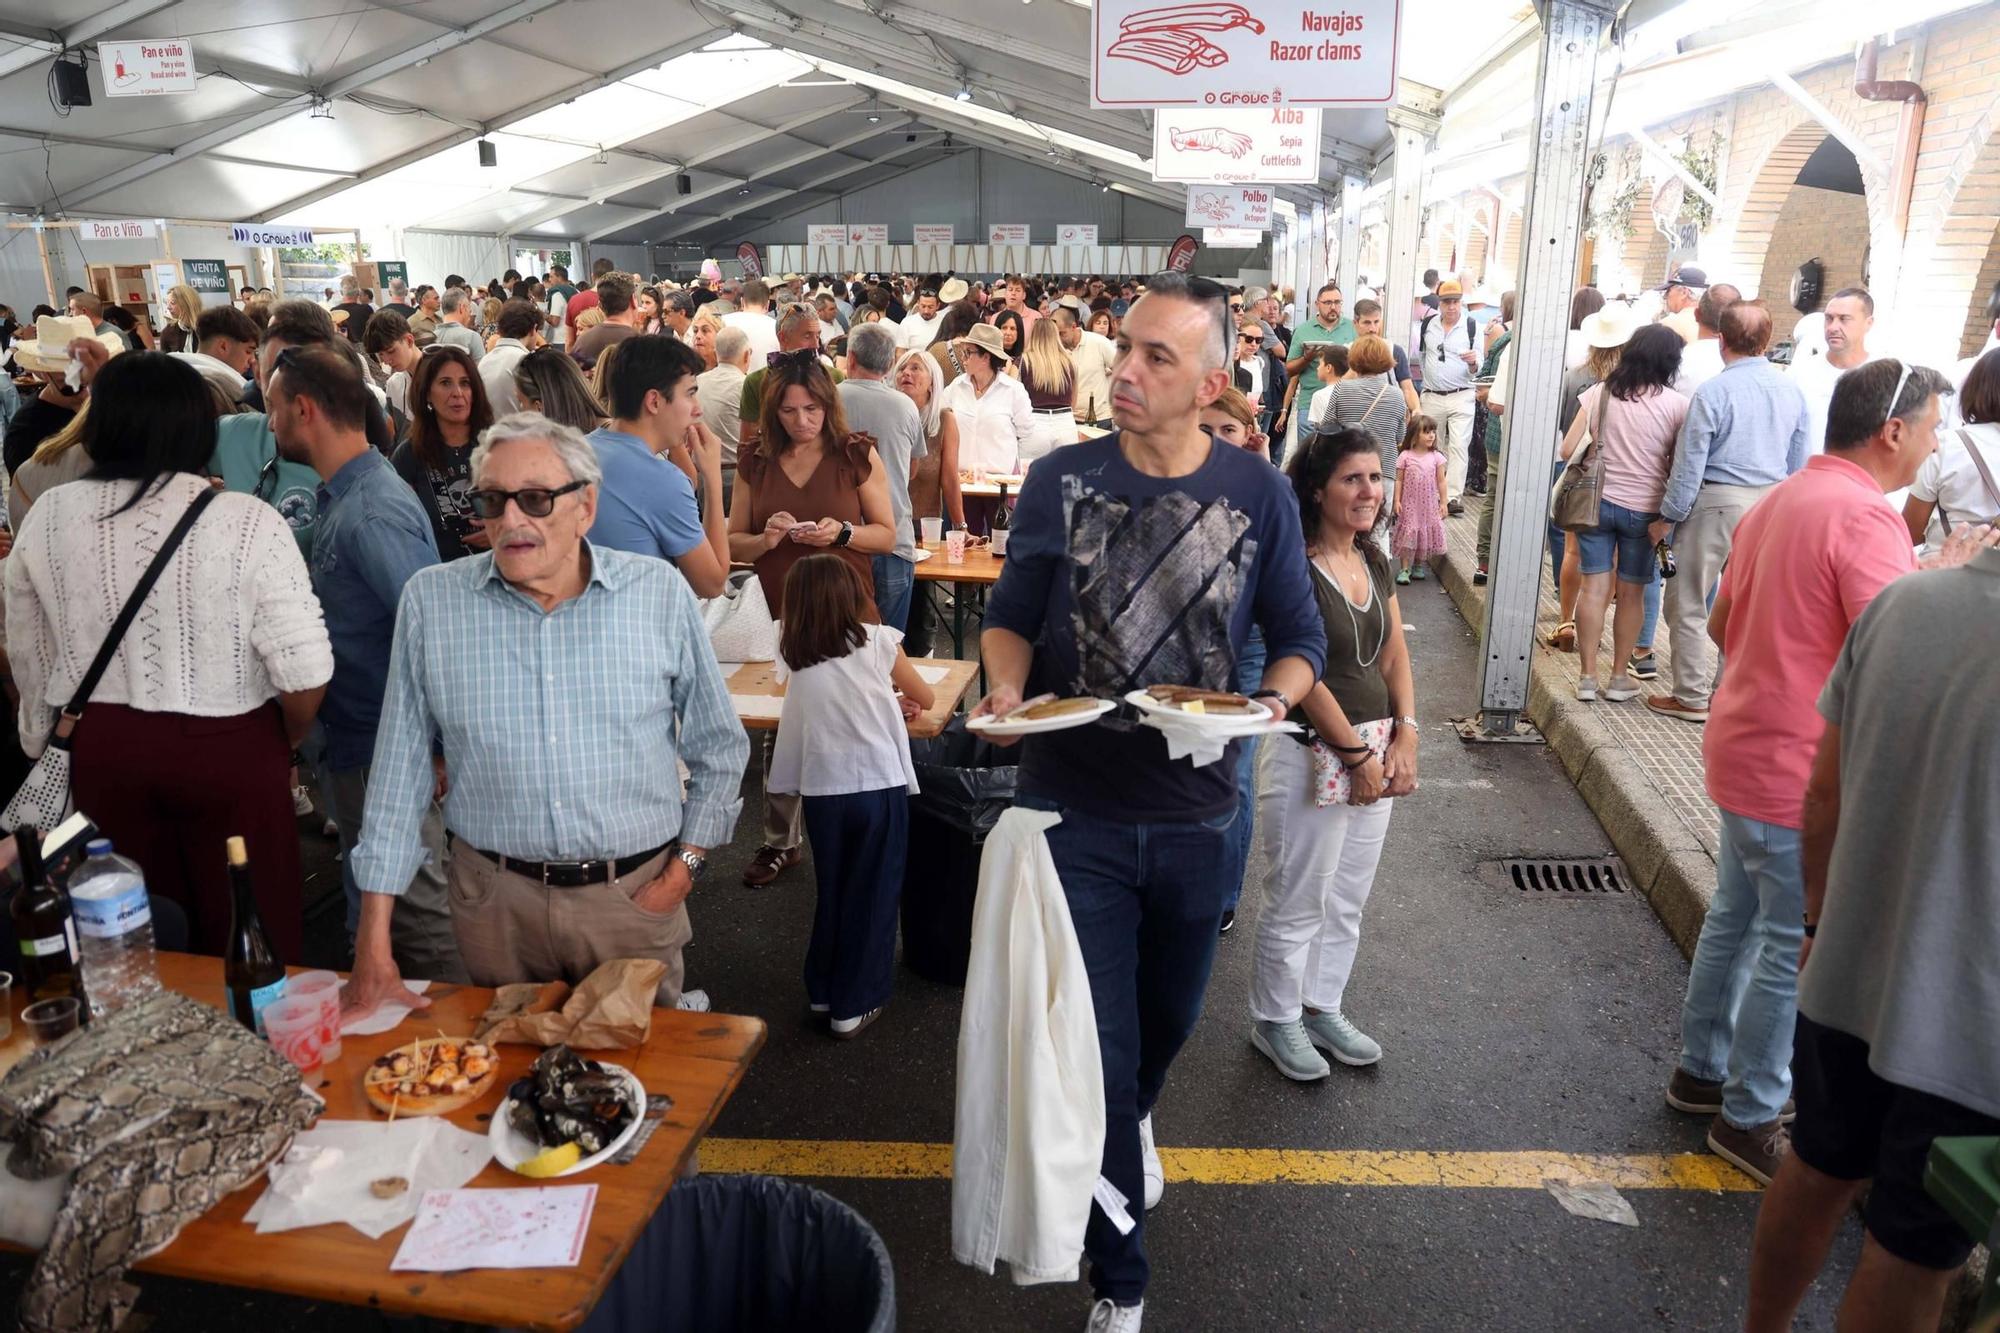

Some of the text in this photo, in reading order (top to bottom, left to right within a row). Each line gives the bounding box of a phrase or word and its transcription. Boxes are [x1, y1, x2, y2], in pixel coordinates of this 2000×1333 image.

[1302, 10, 1363, 36] Navajas
[141, 44, 183, 58] Pan e viño
[1270, 39, 1362, 60] Razor clams
[160, 61, 170, 69] Pan
[150, 70, 186, 79] Bread and wine
[1204, 92, 1216, 104] O
[1272, 107, 1304, 124] Xiba
[1280, 134, 1303, 149] Sepia
[1261, 154, 1302, 166] Cuttlefish
[1242, 189, 1268, 203] Polbo
[1251, 204, 1267, 213] Pulpo
[1244, 213, 1266, 223] Octopus
[93, 221, 143, 238] Pan e Viño
[253, 232, 261, 244] O
[191, 262, 220, 274] VENTA
[385, 264, 401, 272] WINE
[190, 274, 226, 289] DE VIÑO
